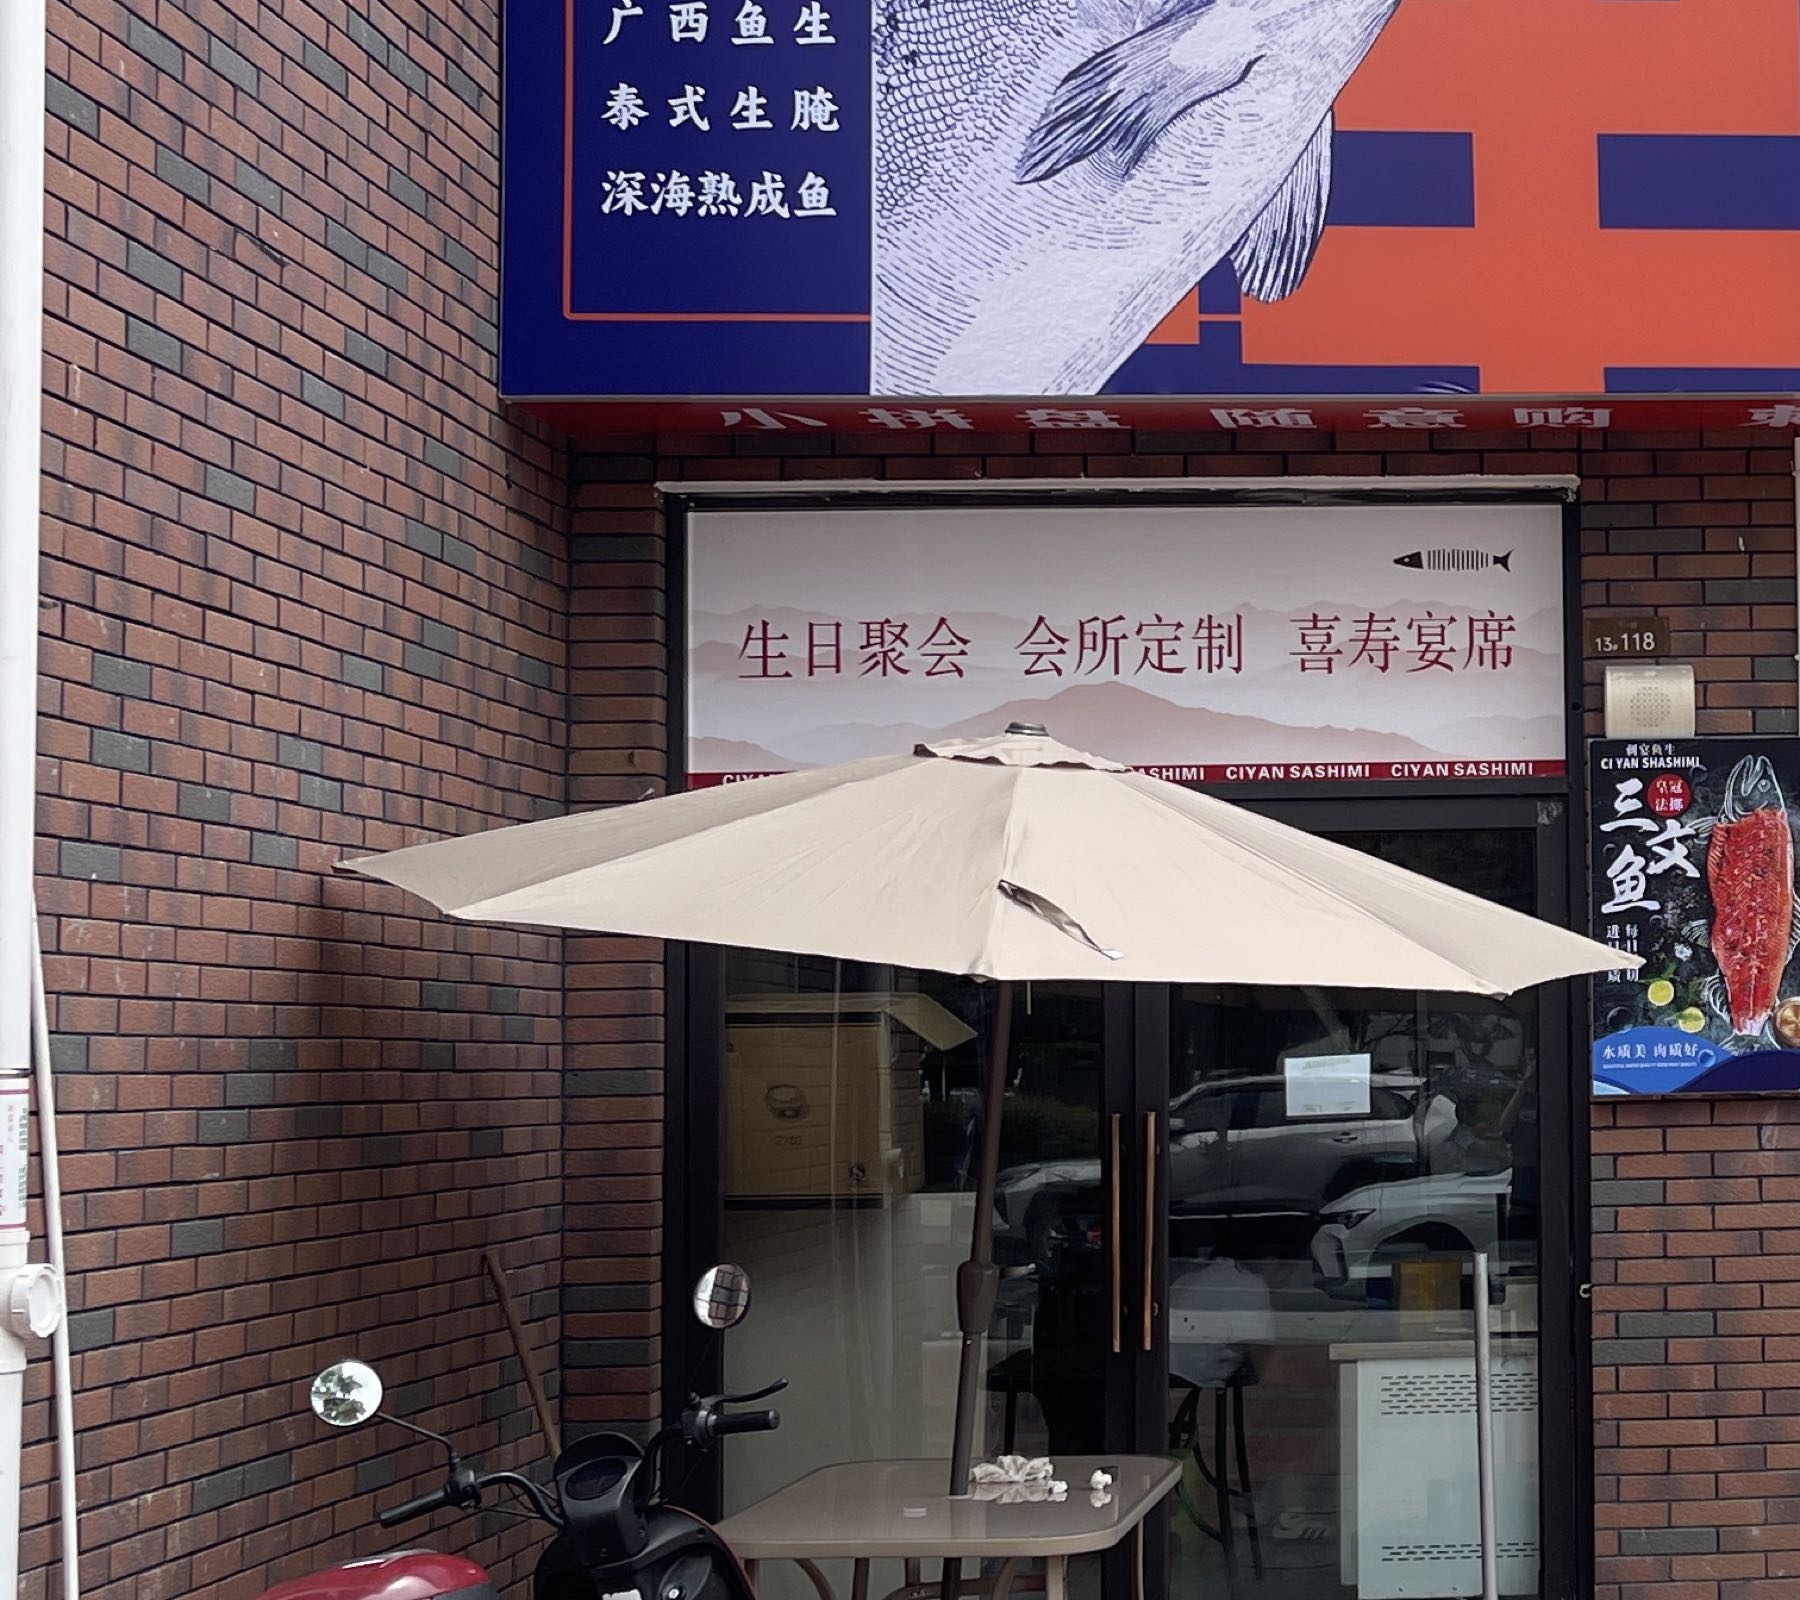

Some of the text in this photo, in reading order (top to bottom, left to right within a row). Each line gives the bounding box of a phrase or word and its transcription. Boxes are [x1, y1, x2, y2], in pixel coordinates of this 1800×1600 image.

[602, 0, 838, 47] 广西鱼生
[601, 82, 840, 134] 泰式生腌
[601, 169, 838, 220] 深海熟成鱼
[738, 610, 1516, 679] 生日聚会 会所定制 喜寿宴席
[1127, 761, 1534, 781] ASHIMI CIYAN SASHIMI CIYAN SASHIMI
[1601, 756, 1700, 770] CI YAN SHASHIMI
